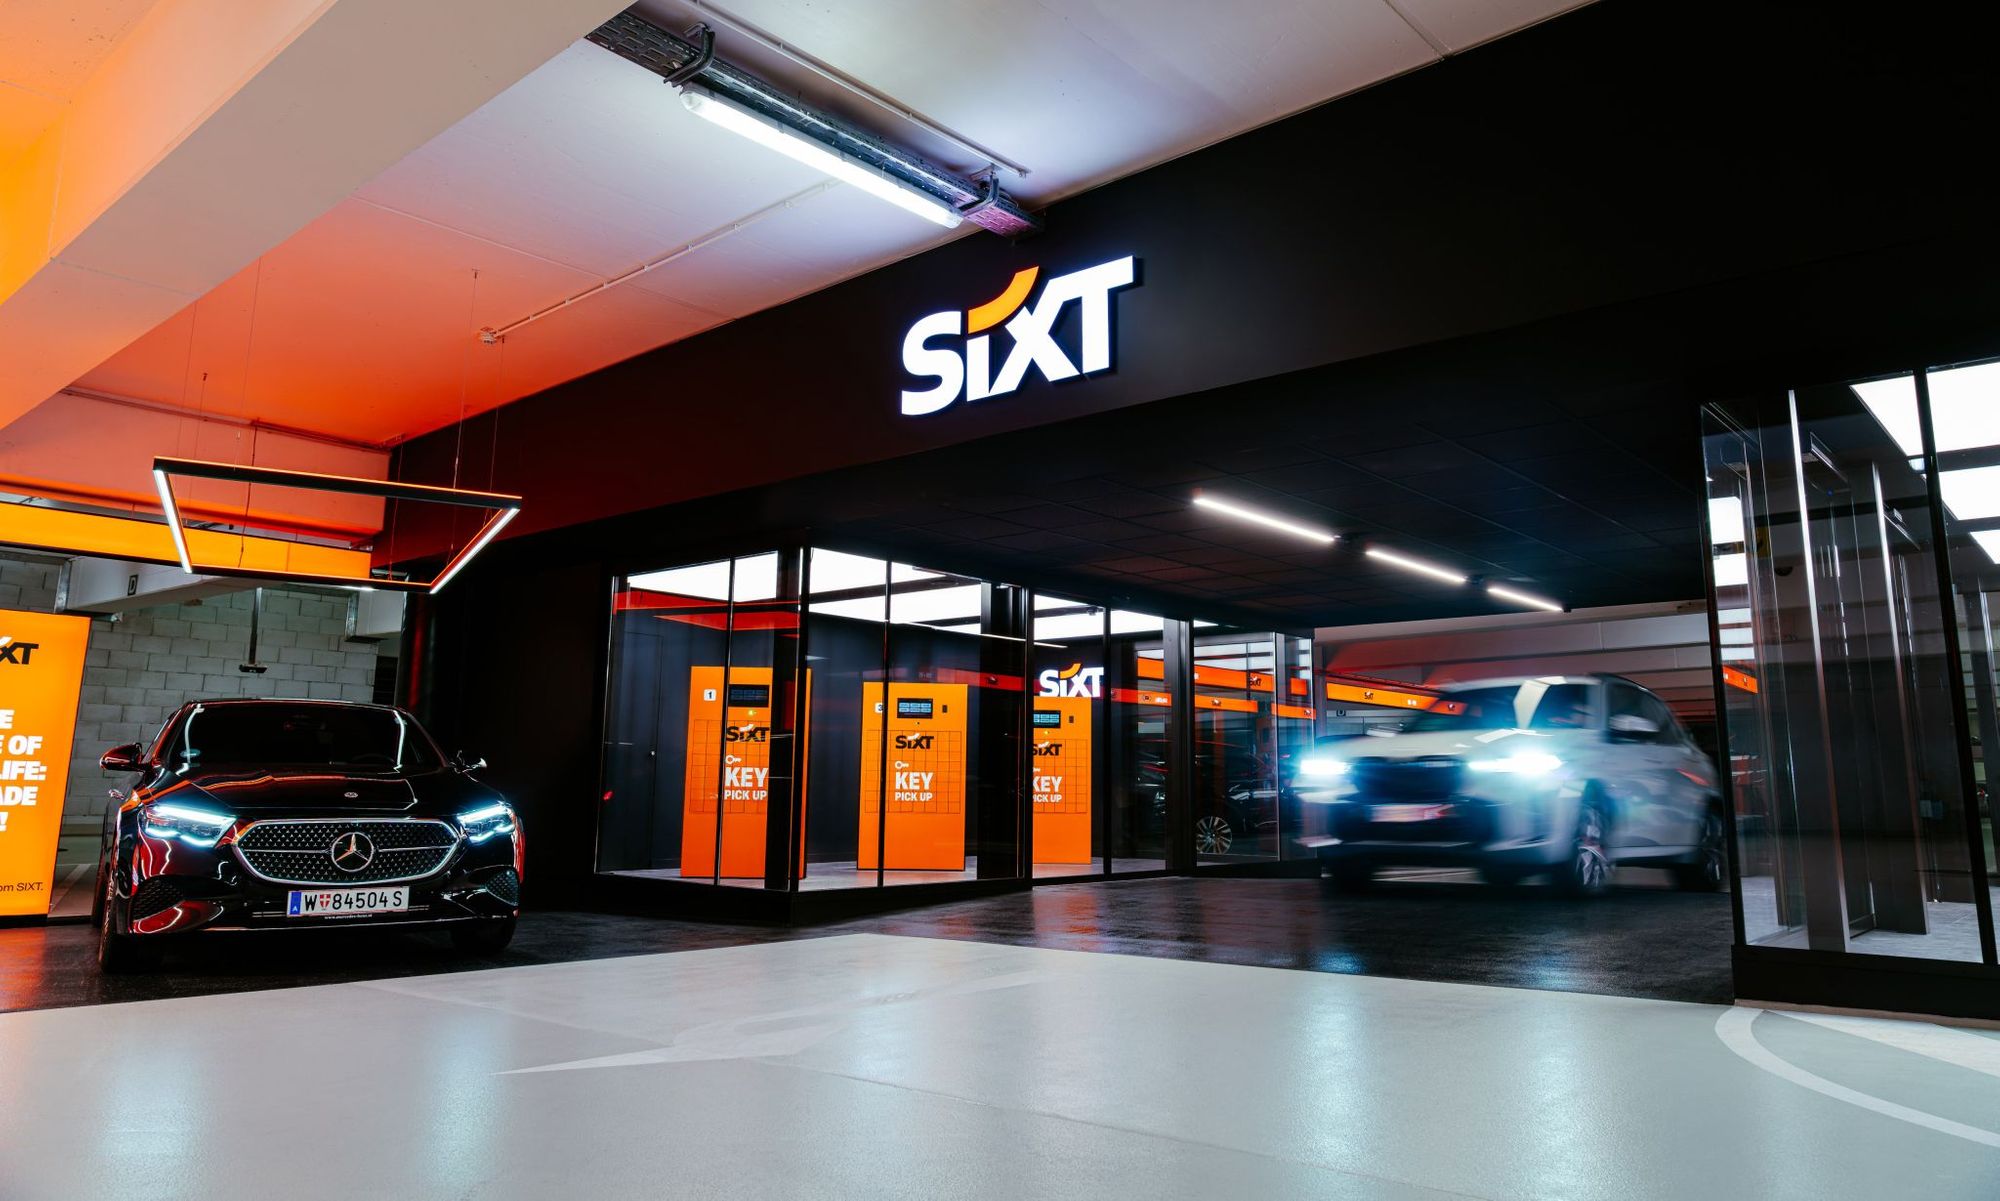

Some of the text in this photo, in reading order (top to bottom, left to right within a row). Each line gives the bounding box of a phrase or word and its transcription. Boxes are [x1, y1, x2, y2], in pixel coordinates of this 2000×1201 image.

[8, 735, 43, 755] OF
[0, 760, 47, 781] IFE:
[725, 767, 769, 787] KEY
[895, 772, 933, 790] KEY
[724, 790, 767, 801] PICK UP
[894, 792, 933, 801] PICK UP
[1033, 794, 1062, 802] ICK UP
[16, 881, 44, 892] SIXT.
[304, 894, 318, 911] W
[332, 891, 388, 910] 84504
[393, 890, 402, 907] S
